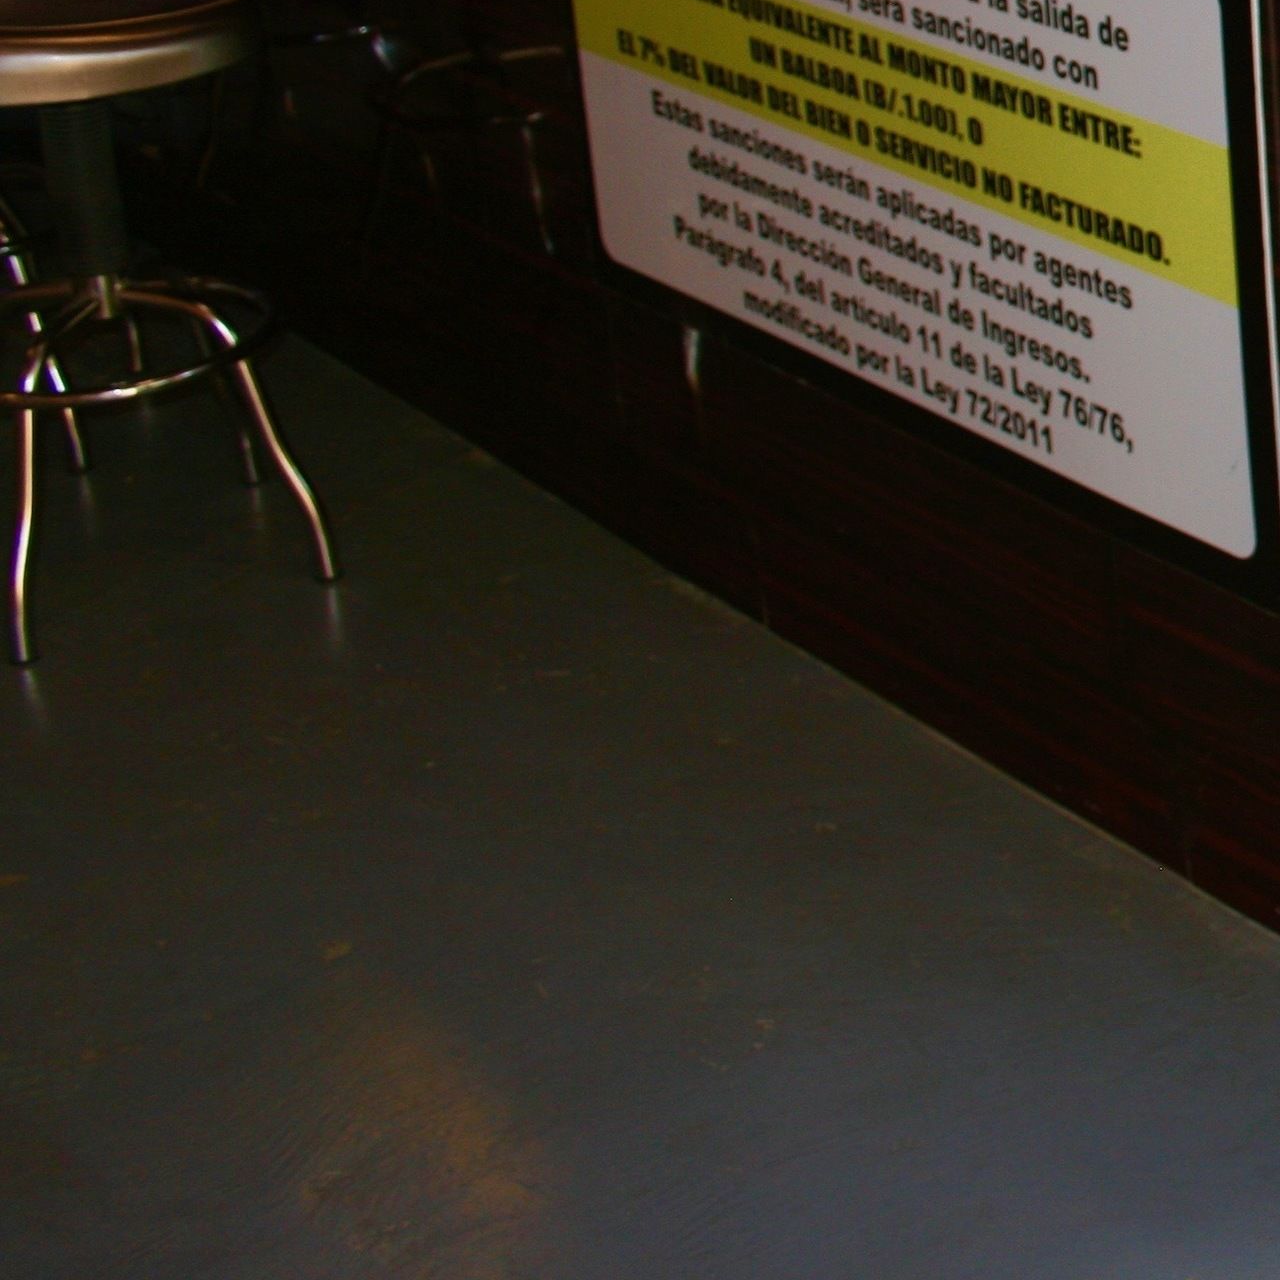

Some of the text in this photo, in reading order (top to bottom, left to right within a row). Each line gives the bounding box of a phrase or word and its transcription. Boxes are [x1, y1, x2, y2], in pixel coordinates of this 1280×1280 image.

[910, 7, 1045, 71] sancionado
[1052, 54, 1098, 90] con
[1097, 15, 1129, 52] de
[650, 89, 1132, 309] Estas sanciones serán aplicadas por agentes
[1018, 181, 1169, 265] FACTURADO.
[697, 193, 1090, 383] por la Dirección General de Ingresos.
[948, 260, 962, 288] y
[967, 261, 1092, 339] facultados
[894, 355, 915, 388] la
[919, 367, 959, 414] Ley
[965, 388, 1052, 454] 72/2011
[916, 325, 941, 358] 11
[948, 342, 977, 375] de
[982, 354, 1004, 388] la
[1010, 366, 1052, 416] Ley
[1058, 388, 1133, 453] 76/76,
